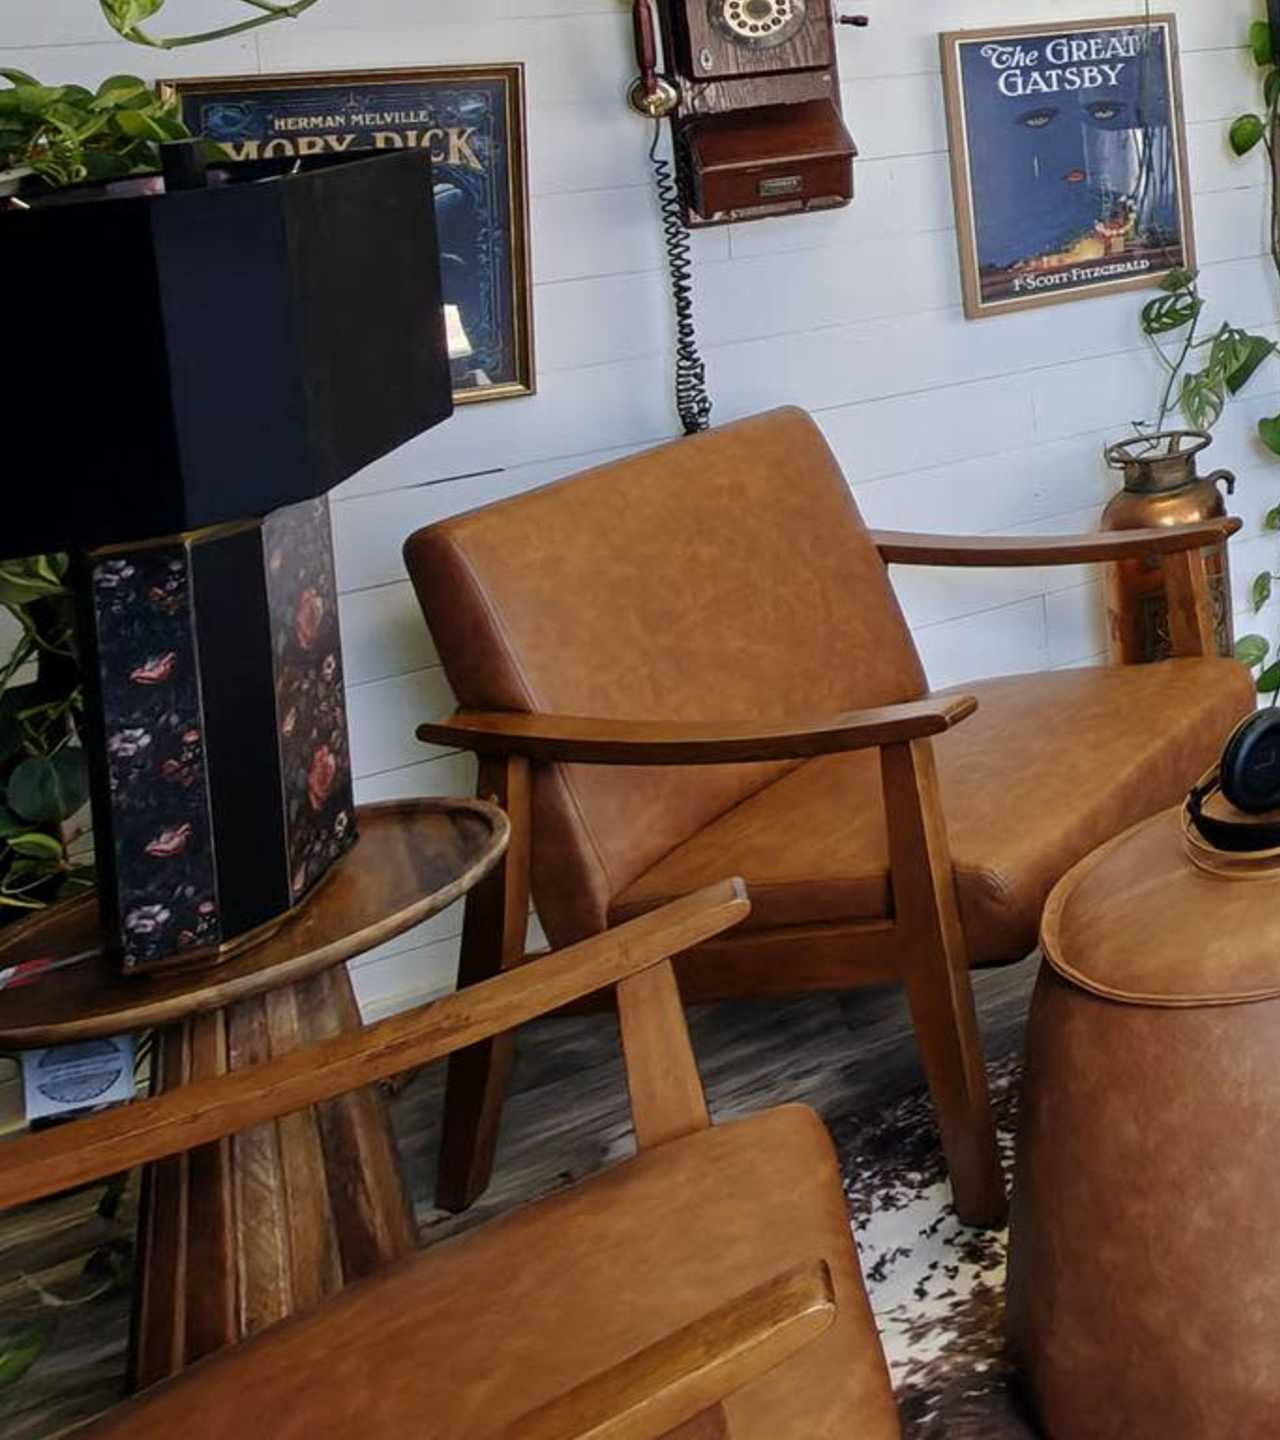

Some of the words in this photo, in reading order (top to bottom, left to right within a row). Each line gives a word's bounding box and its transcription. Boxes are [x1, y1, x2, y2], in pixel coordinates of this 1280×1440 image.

[981, 44, 1038, 68] The
[1046, 36, 1140, 63] GREAT
[999, 63, 1125, 96] GATSBY
[274, 115, 346, 130] HERMAN
[351, 110, 429, 125] MELVILLE
